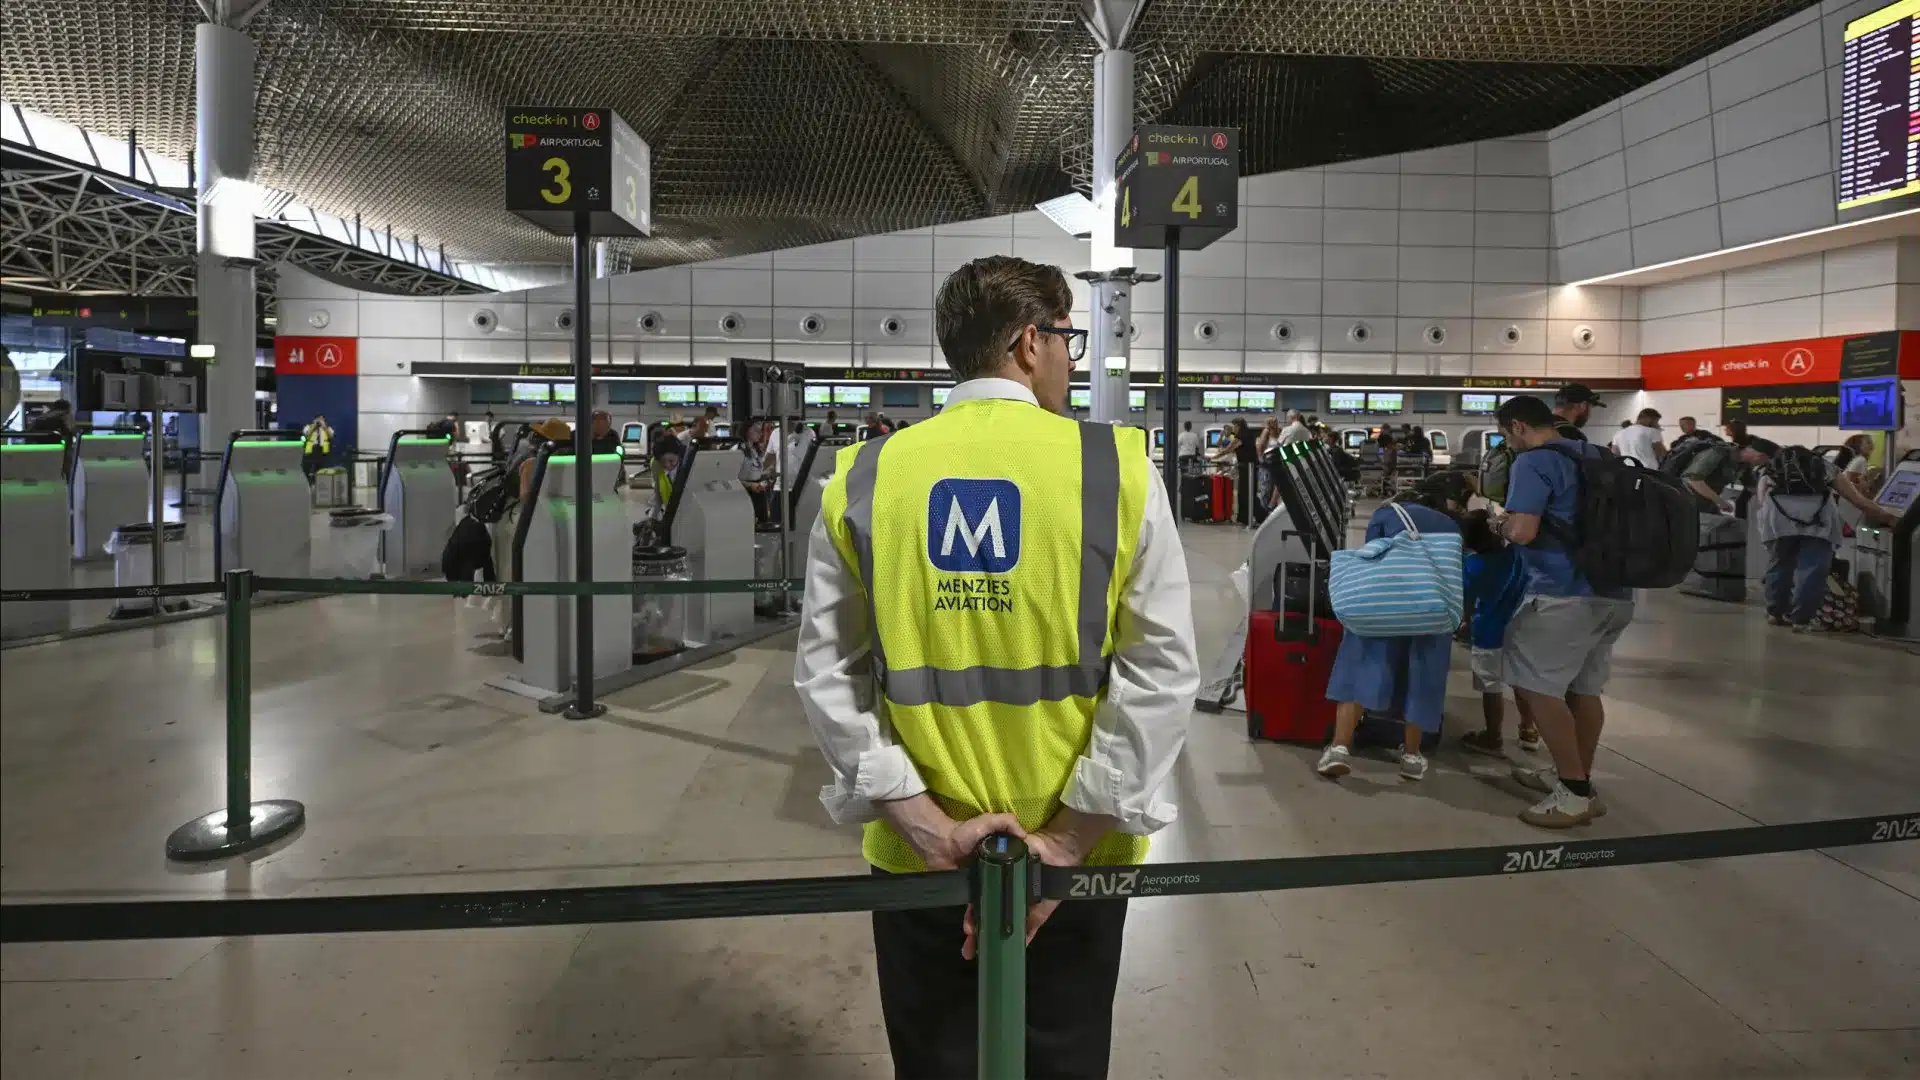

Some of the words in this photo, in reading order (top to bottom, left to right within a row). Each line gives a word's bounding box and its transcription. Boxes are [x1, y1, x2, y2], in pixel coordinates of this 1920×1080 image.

[512, 113, 568, 125] check-in
[1148, 132, 1198, 144] check-in
[540, 157, 572, 204] 3
[626, 175, 636, 220] 3
[1171, 175, 1202, 220] 4
[1121, 185, 1131, 228] 4
[1790, 354, 1806, 370] A
[1748, 397, 1779, 406] portas
[1781, 396, 1794, 405] de
[1748, 406, 1789, 415] boarding
[1790, 405, 1819, 415] gates
[940, 494, 1006, 558] M
[938, 579, 1010, 595] MENZIES
[934, 596, 1012, 612] AVIATION
[1564, 849, 1616, 862] Aeroportos
[1141, 874, 1200, 886] Aeroportos
[1140, 886, 1162, 894] Lisboa
